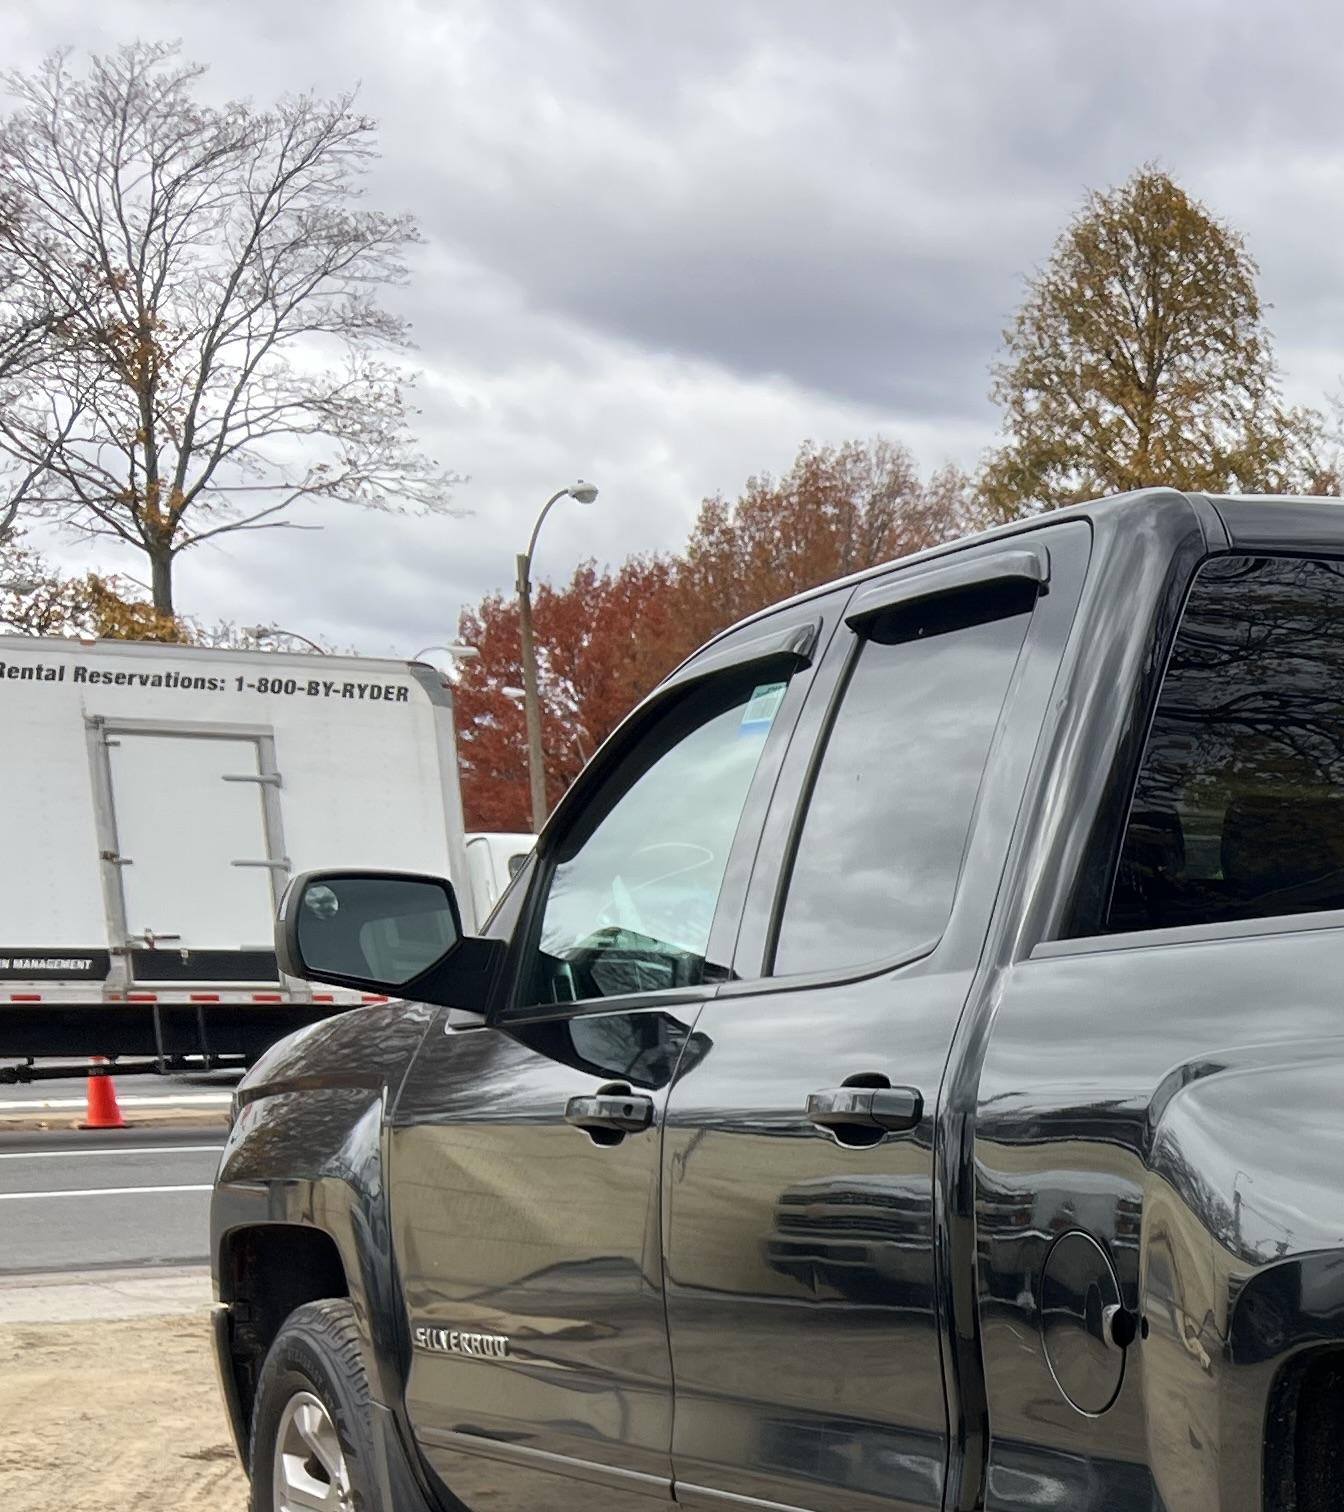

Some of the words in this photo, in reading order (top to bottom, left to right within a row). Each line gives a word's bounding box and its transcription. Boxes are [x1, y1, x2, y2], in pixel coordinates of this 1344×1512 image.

[73, 665, 226, 692] Reservations:
[234, 675, 409, 703] 1-800-BY-RYDER
[416, 1327, 510, 1357] SILVERADO
